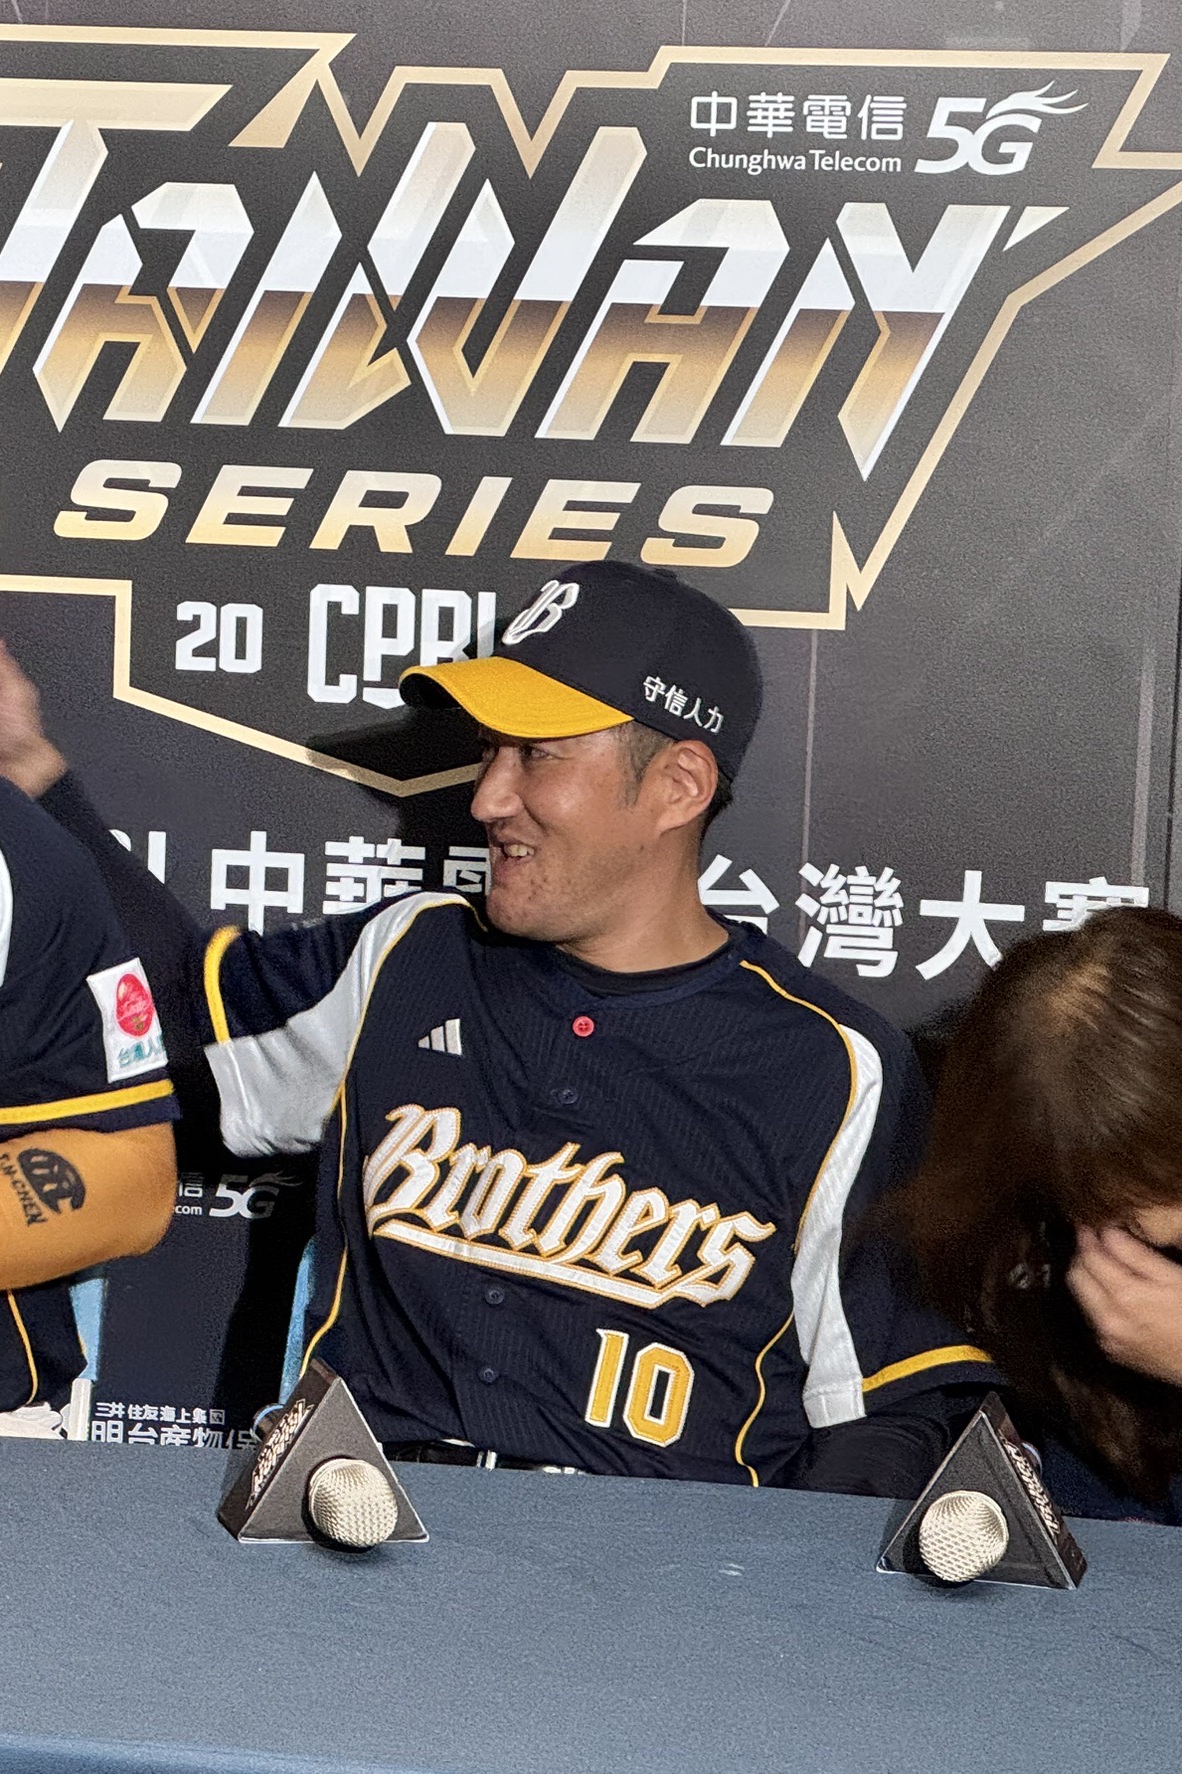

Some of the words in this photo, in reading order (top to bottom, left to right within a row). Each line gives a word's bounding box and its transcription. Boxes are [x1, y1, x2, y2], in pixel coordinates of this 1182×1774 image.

[690, 91, 907, 141] 中華電信
[915, 90, 1058, 175] 5G
[689, 147, 806, 175] Chunghwa
[809, 150, 902, 172] Telecom
[53, 458, 774, 568] SERIES
[175, 600, 263, 674] 20
[643, 675, 724, 734] 守信人力
[363, 1104, 775, 1309] Brothers
[585, 1328, 694, 1447] 10
